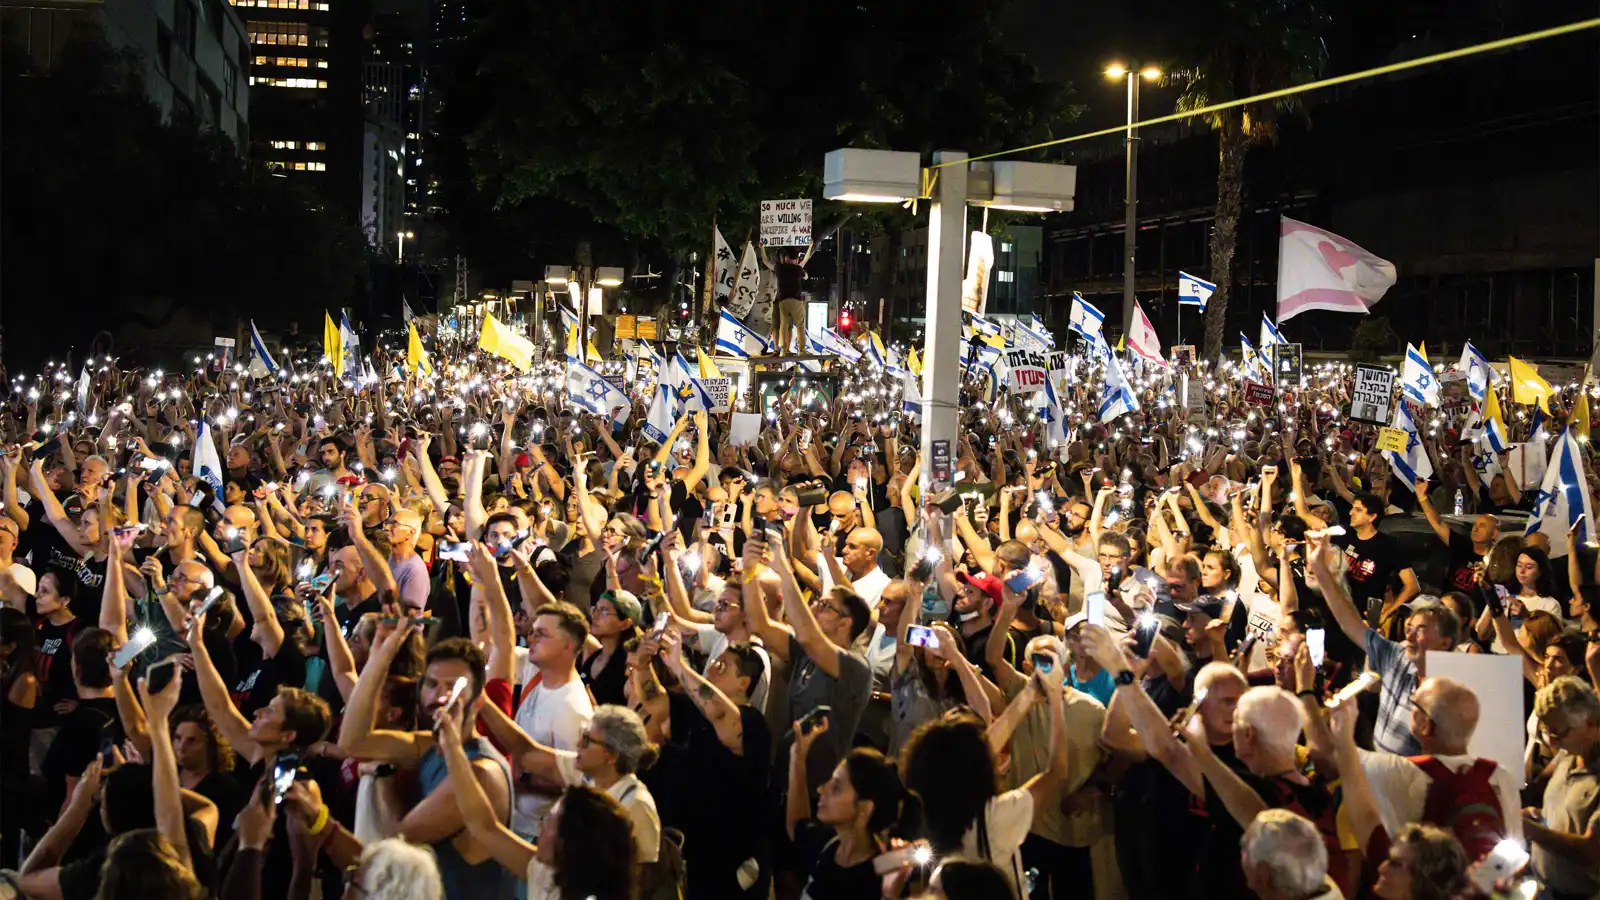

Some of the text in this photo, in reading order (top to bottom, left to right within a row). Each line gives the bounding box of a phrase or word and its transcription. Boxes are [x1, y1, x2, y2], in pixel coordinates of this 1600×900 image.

[762, 203, 771, 211] SO
[776, 202, 796, 210] MUCH
[1360, 381, 1387, 393] בקצה
